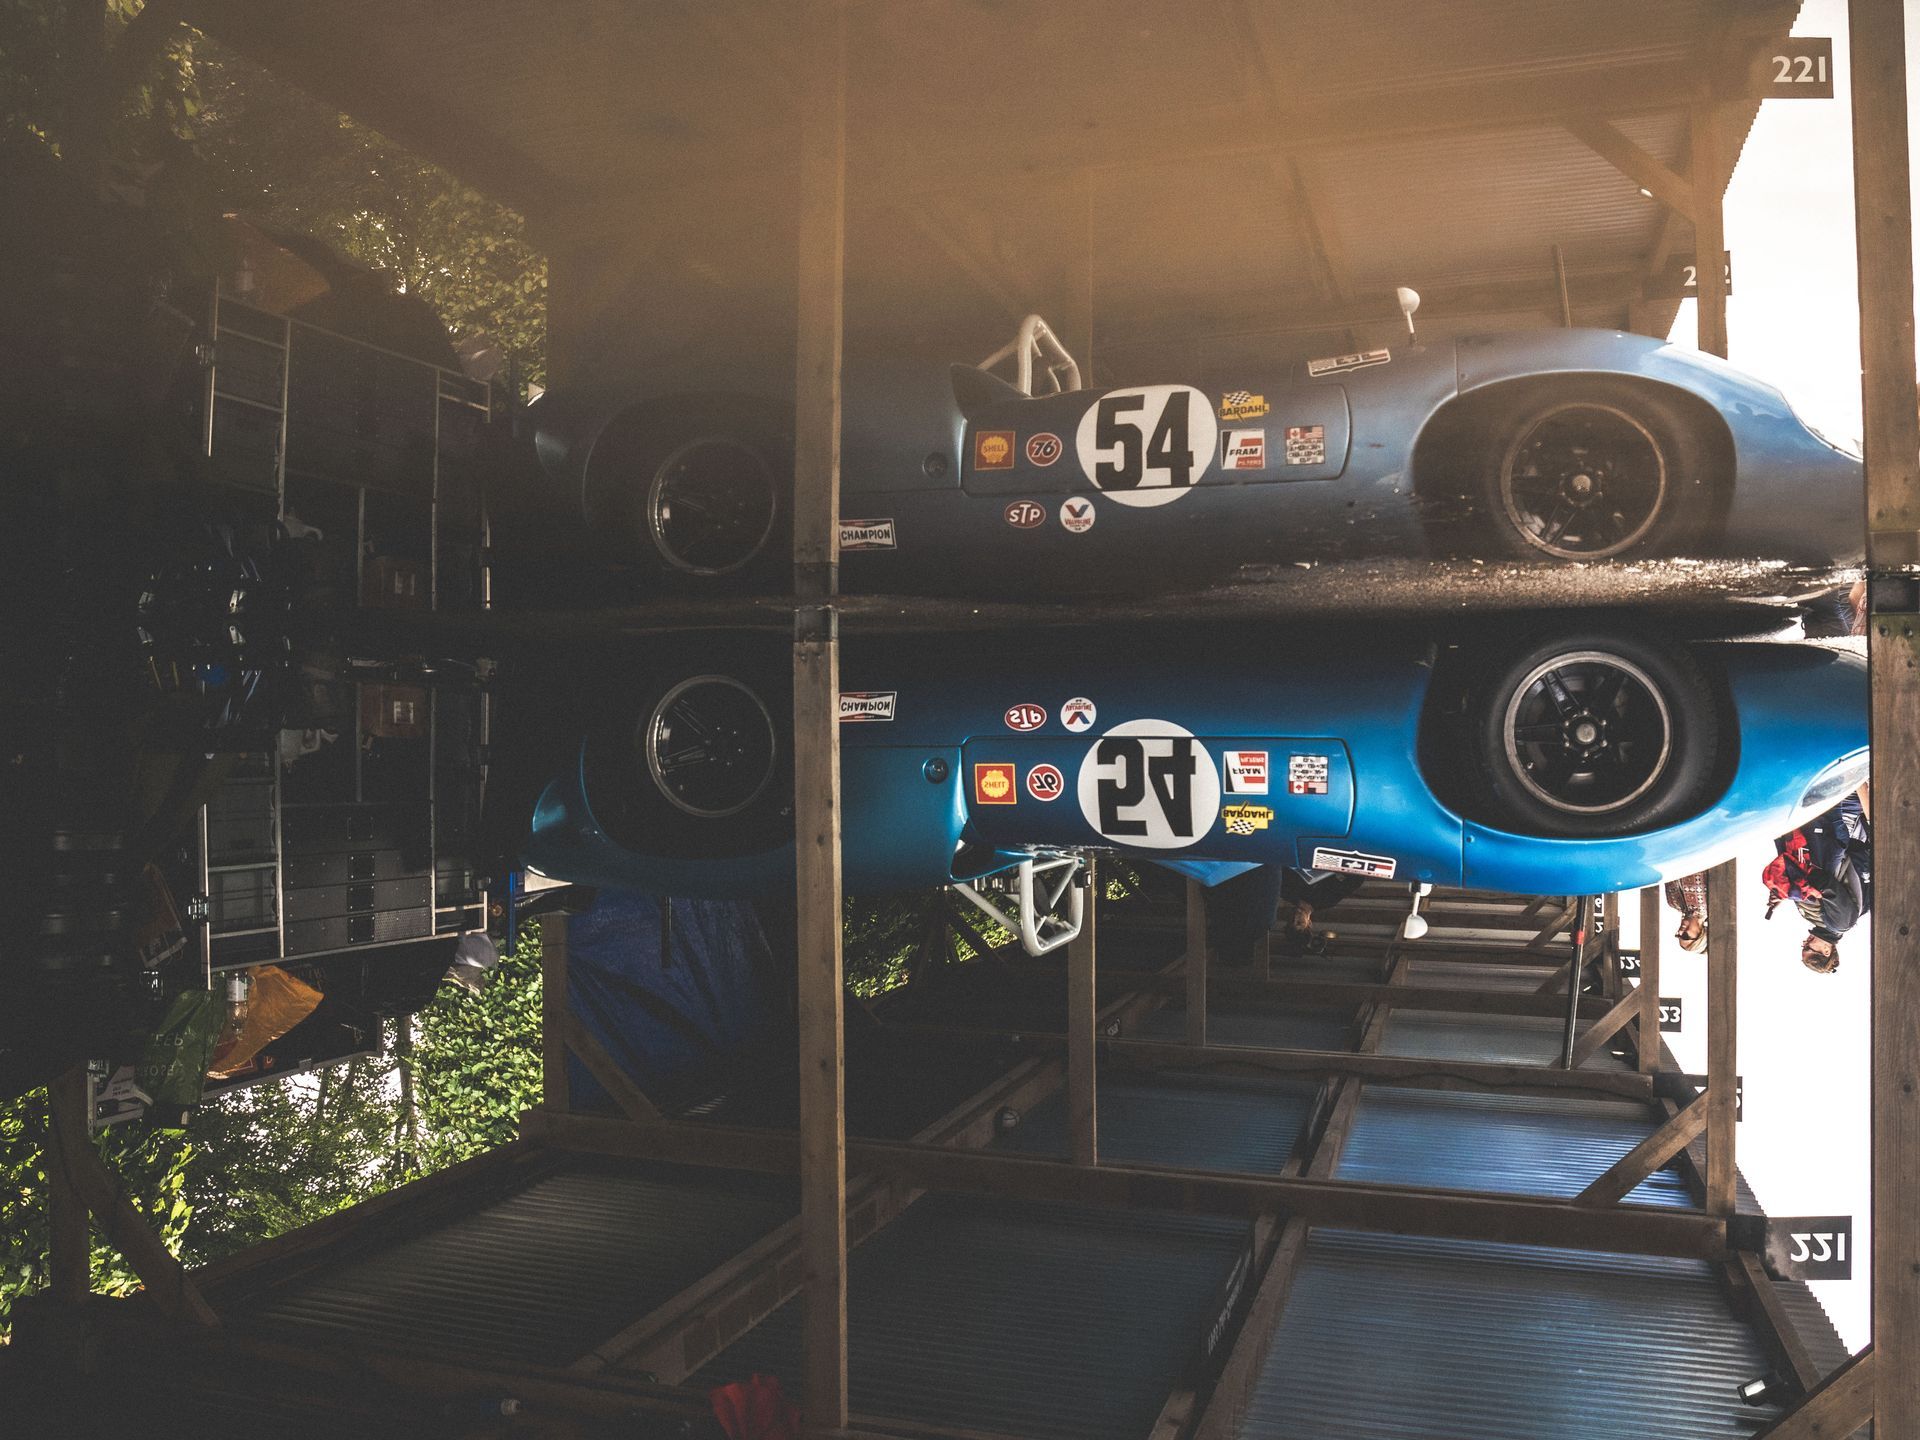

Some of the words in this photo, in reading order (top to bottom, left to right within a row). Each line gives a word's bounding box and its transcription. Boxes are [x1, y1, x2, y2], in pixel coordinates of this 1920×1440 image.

[1772, 55, 1827, 83] 221
[1219, 403, 1269, 417] BARDAHL
[983, 444, 1005, 453] SHELL
[1095, 390, 1194, 491] 54
[1031, 440, 1057, 458] 76
[1229, 447, 1258, 456] FRAM
[1009, 504, 1041, 523] STP
[841, 529, 891, 541] CHAMPION
